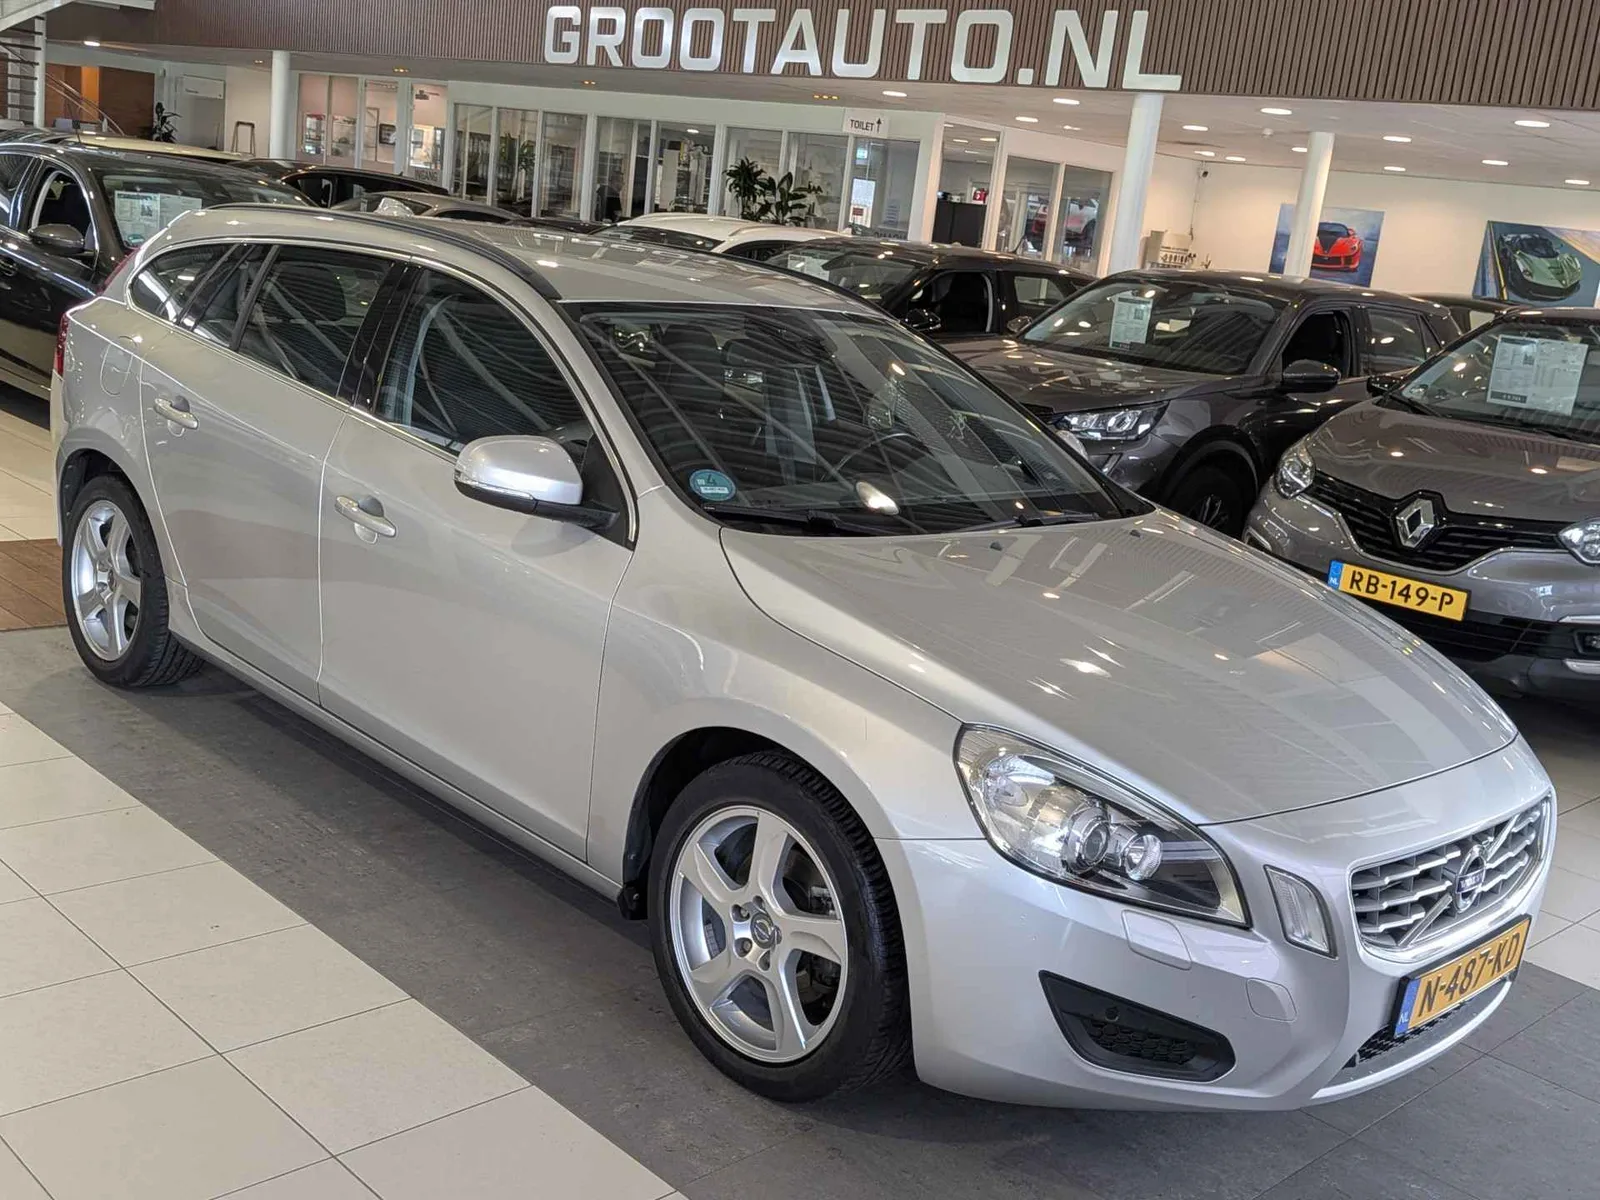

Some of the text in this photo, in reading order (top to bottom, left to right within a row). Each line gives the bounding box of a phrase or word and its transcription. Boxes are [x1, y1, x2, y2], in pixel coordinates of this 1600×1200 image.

[544, 4, 1183, 92] GROOTAUTO.NL
[850, 119, 874, 131] TOILET
[1349, 570, 1454, 612] RB-149-P
[1418, 932, 1520, 1017] N-487-KD
